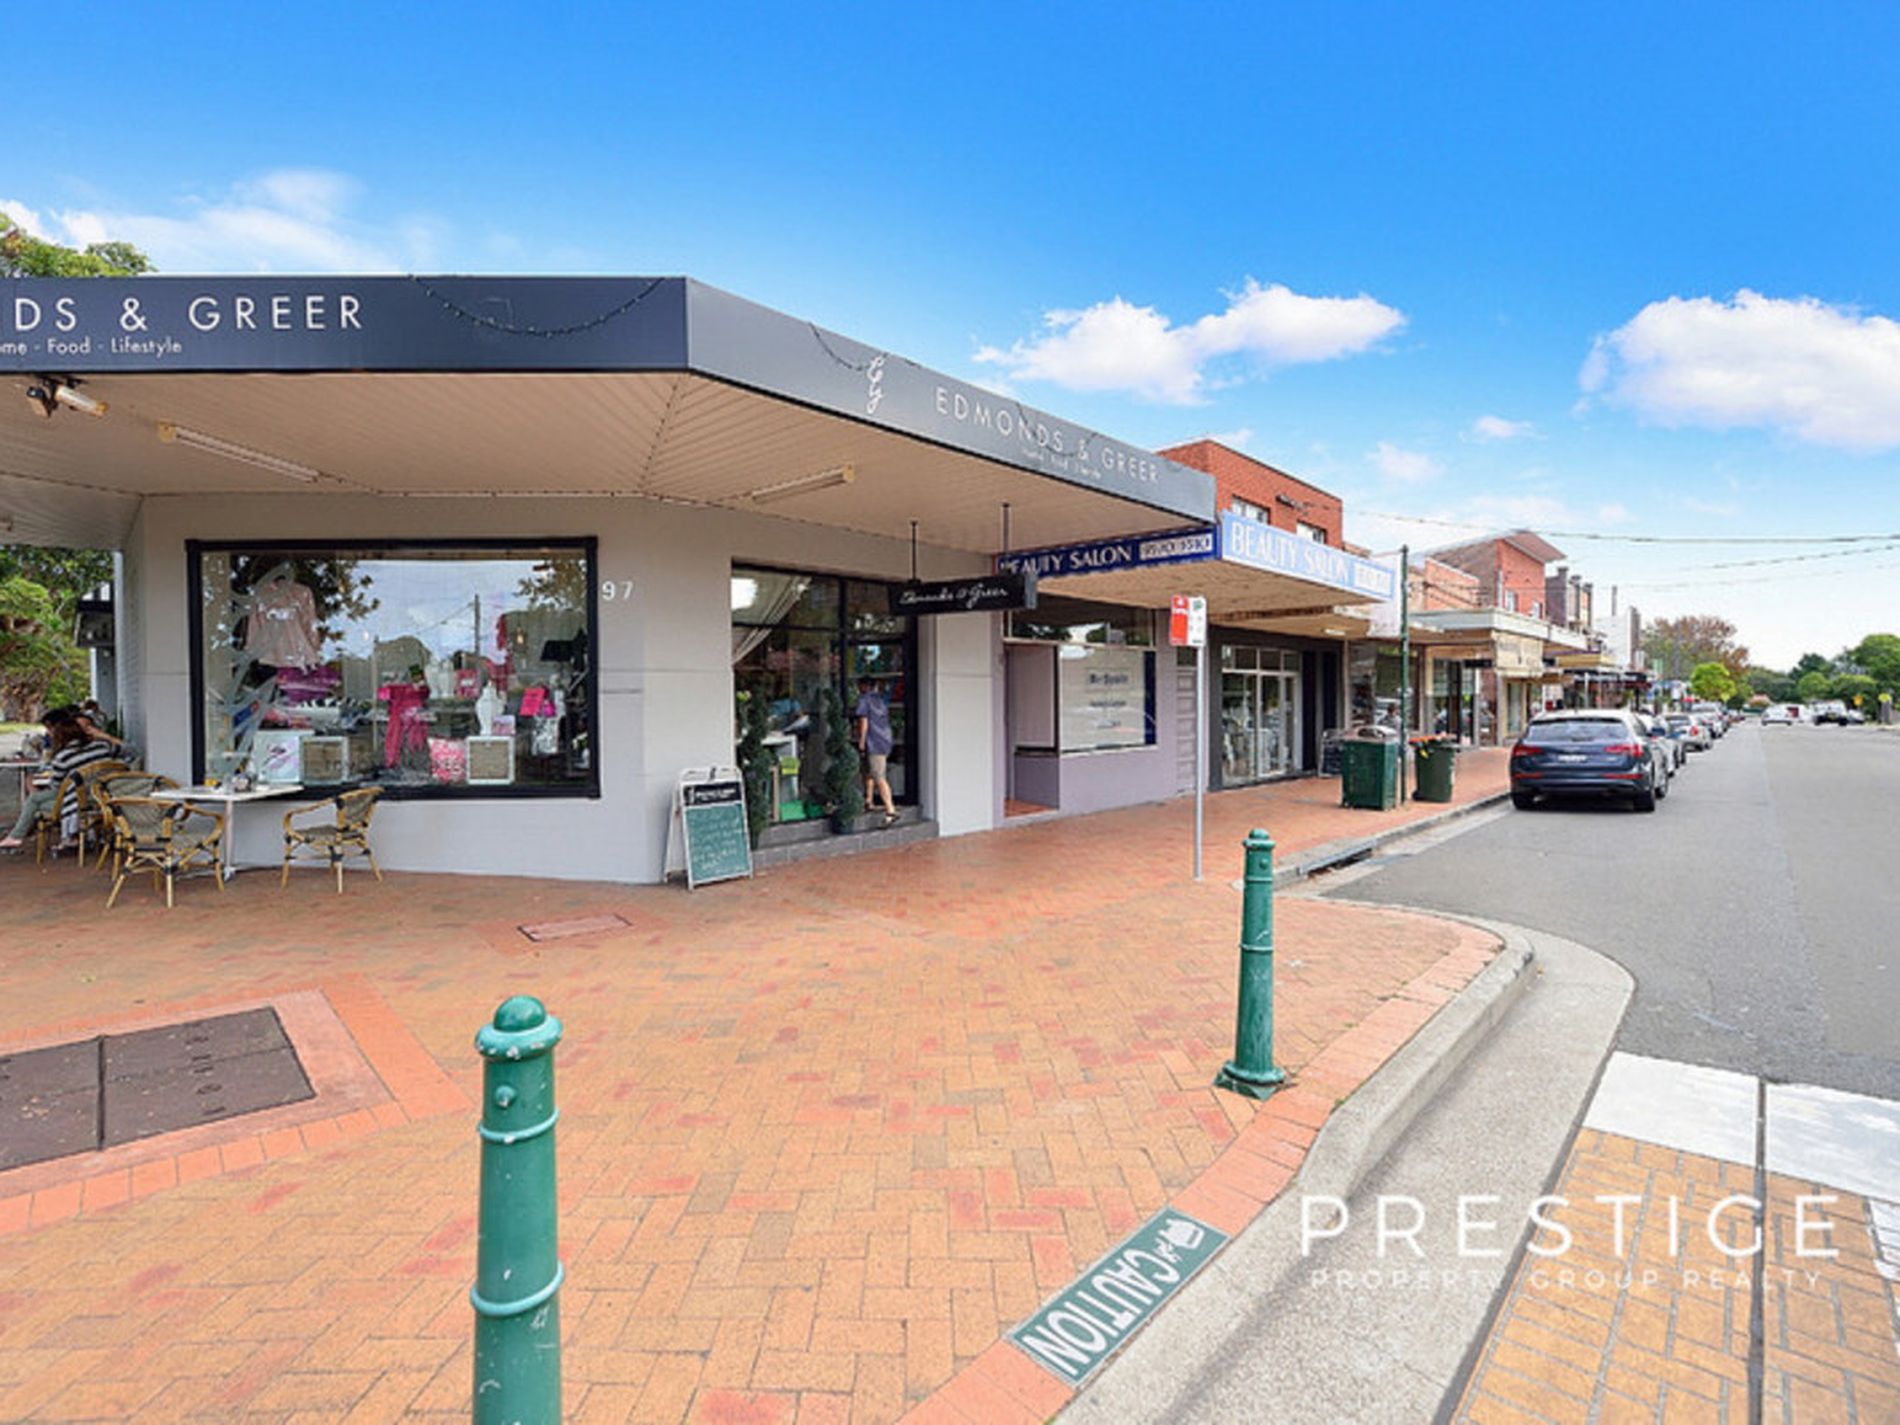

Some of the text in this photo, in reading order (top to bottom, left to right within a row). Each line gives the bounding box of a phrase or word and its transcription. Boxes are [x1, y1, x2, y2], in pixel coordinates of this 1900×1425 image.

[120, 297, 148, 331] &
[189, 295, 362, 331] GREER
[0, 339, 28, 356] me
[48, 337, 91, 355] Food
[112, 336, 182, 358] Lifestyle
[935, 386, 1064, 452] EDMONDS
[1078, 438, 1089, 462] &
[1102, 447, 1159, 483] GREER
[1070, 545, 1132, 569] SALON
[1231, 520, 1297, 569] BEAUTY
[602, 580, 634, 600] 97
[1021, 1249, 1181, 1377] CAUTION
